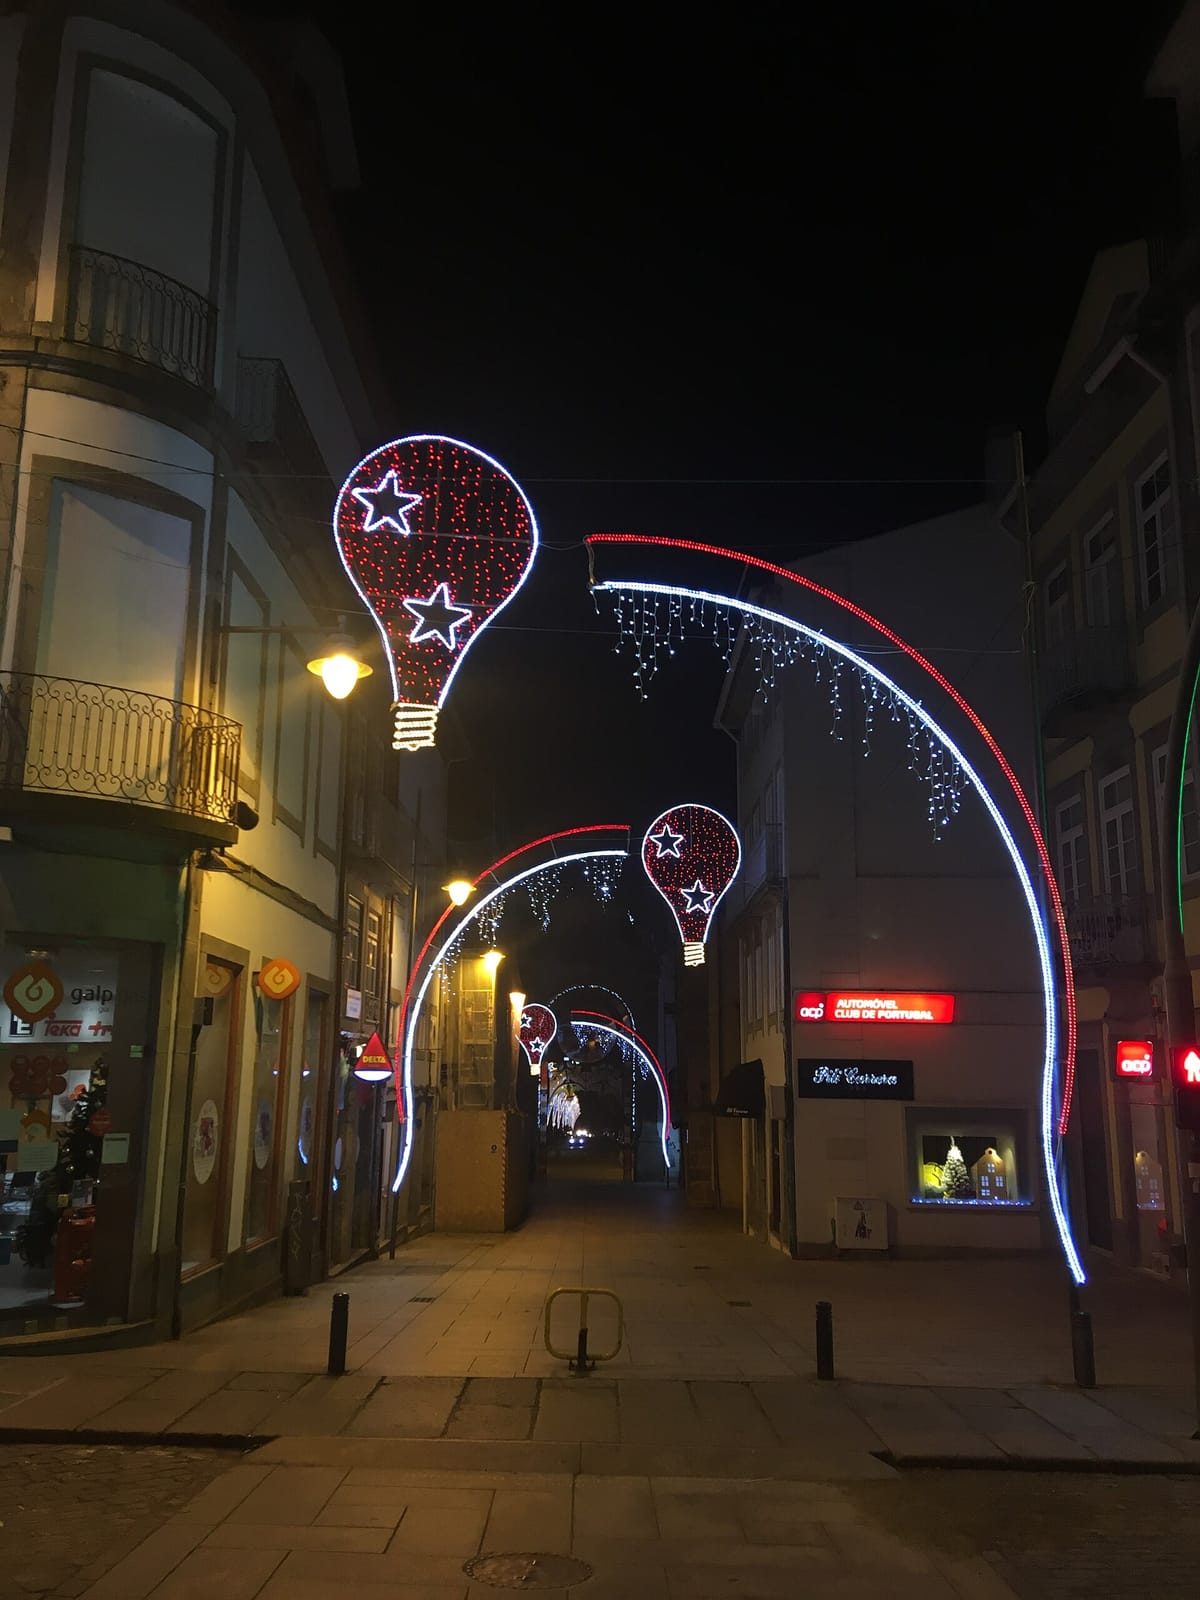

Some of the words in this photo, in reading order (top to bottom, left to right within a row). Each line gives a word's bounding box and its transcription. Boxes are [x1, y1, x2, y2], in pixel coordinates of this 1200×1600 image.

[71, 985, 113, 1005] galp
[836, 998, 898, 1010] AUTOMÓVEL
[800, 1003, 824, 1019] acp
[834, 1009, 861, 1019] CLUB
[862, 1010, 875, 1019] DE
[877, 1010, 934, 1020] PORTUGAL
[362, 1055, 387, 1064] DELTA
